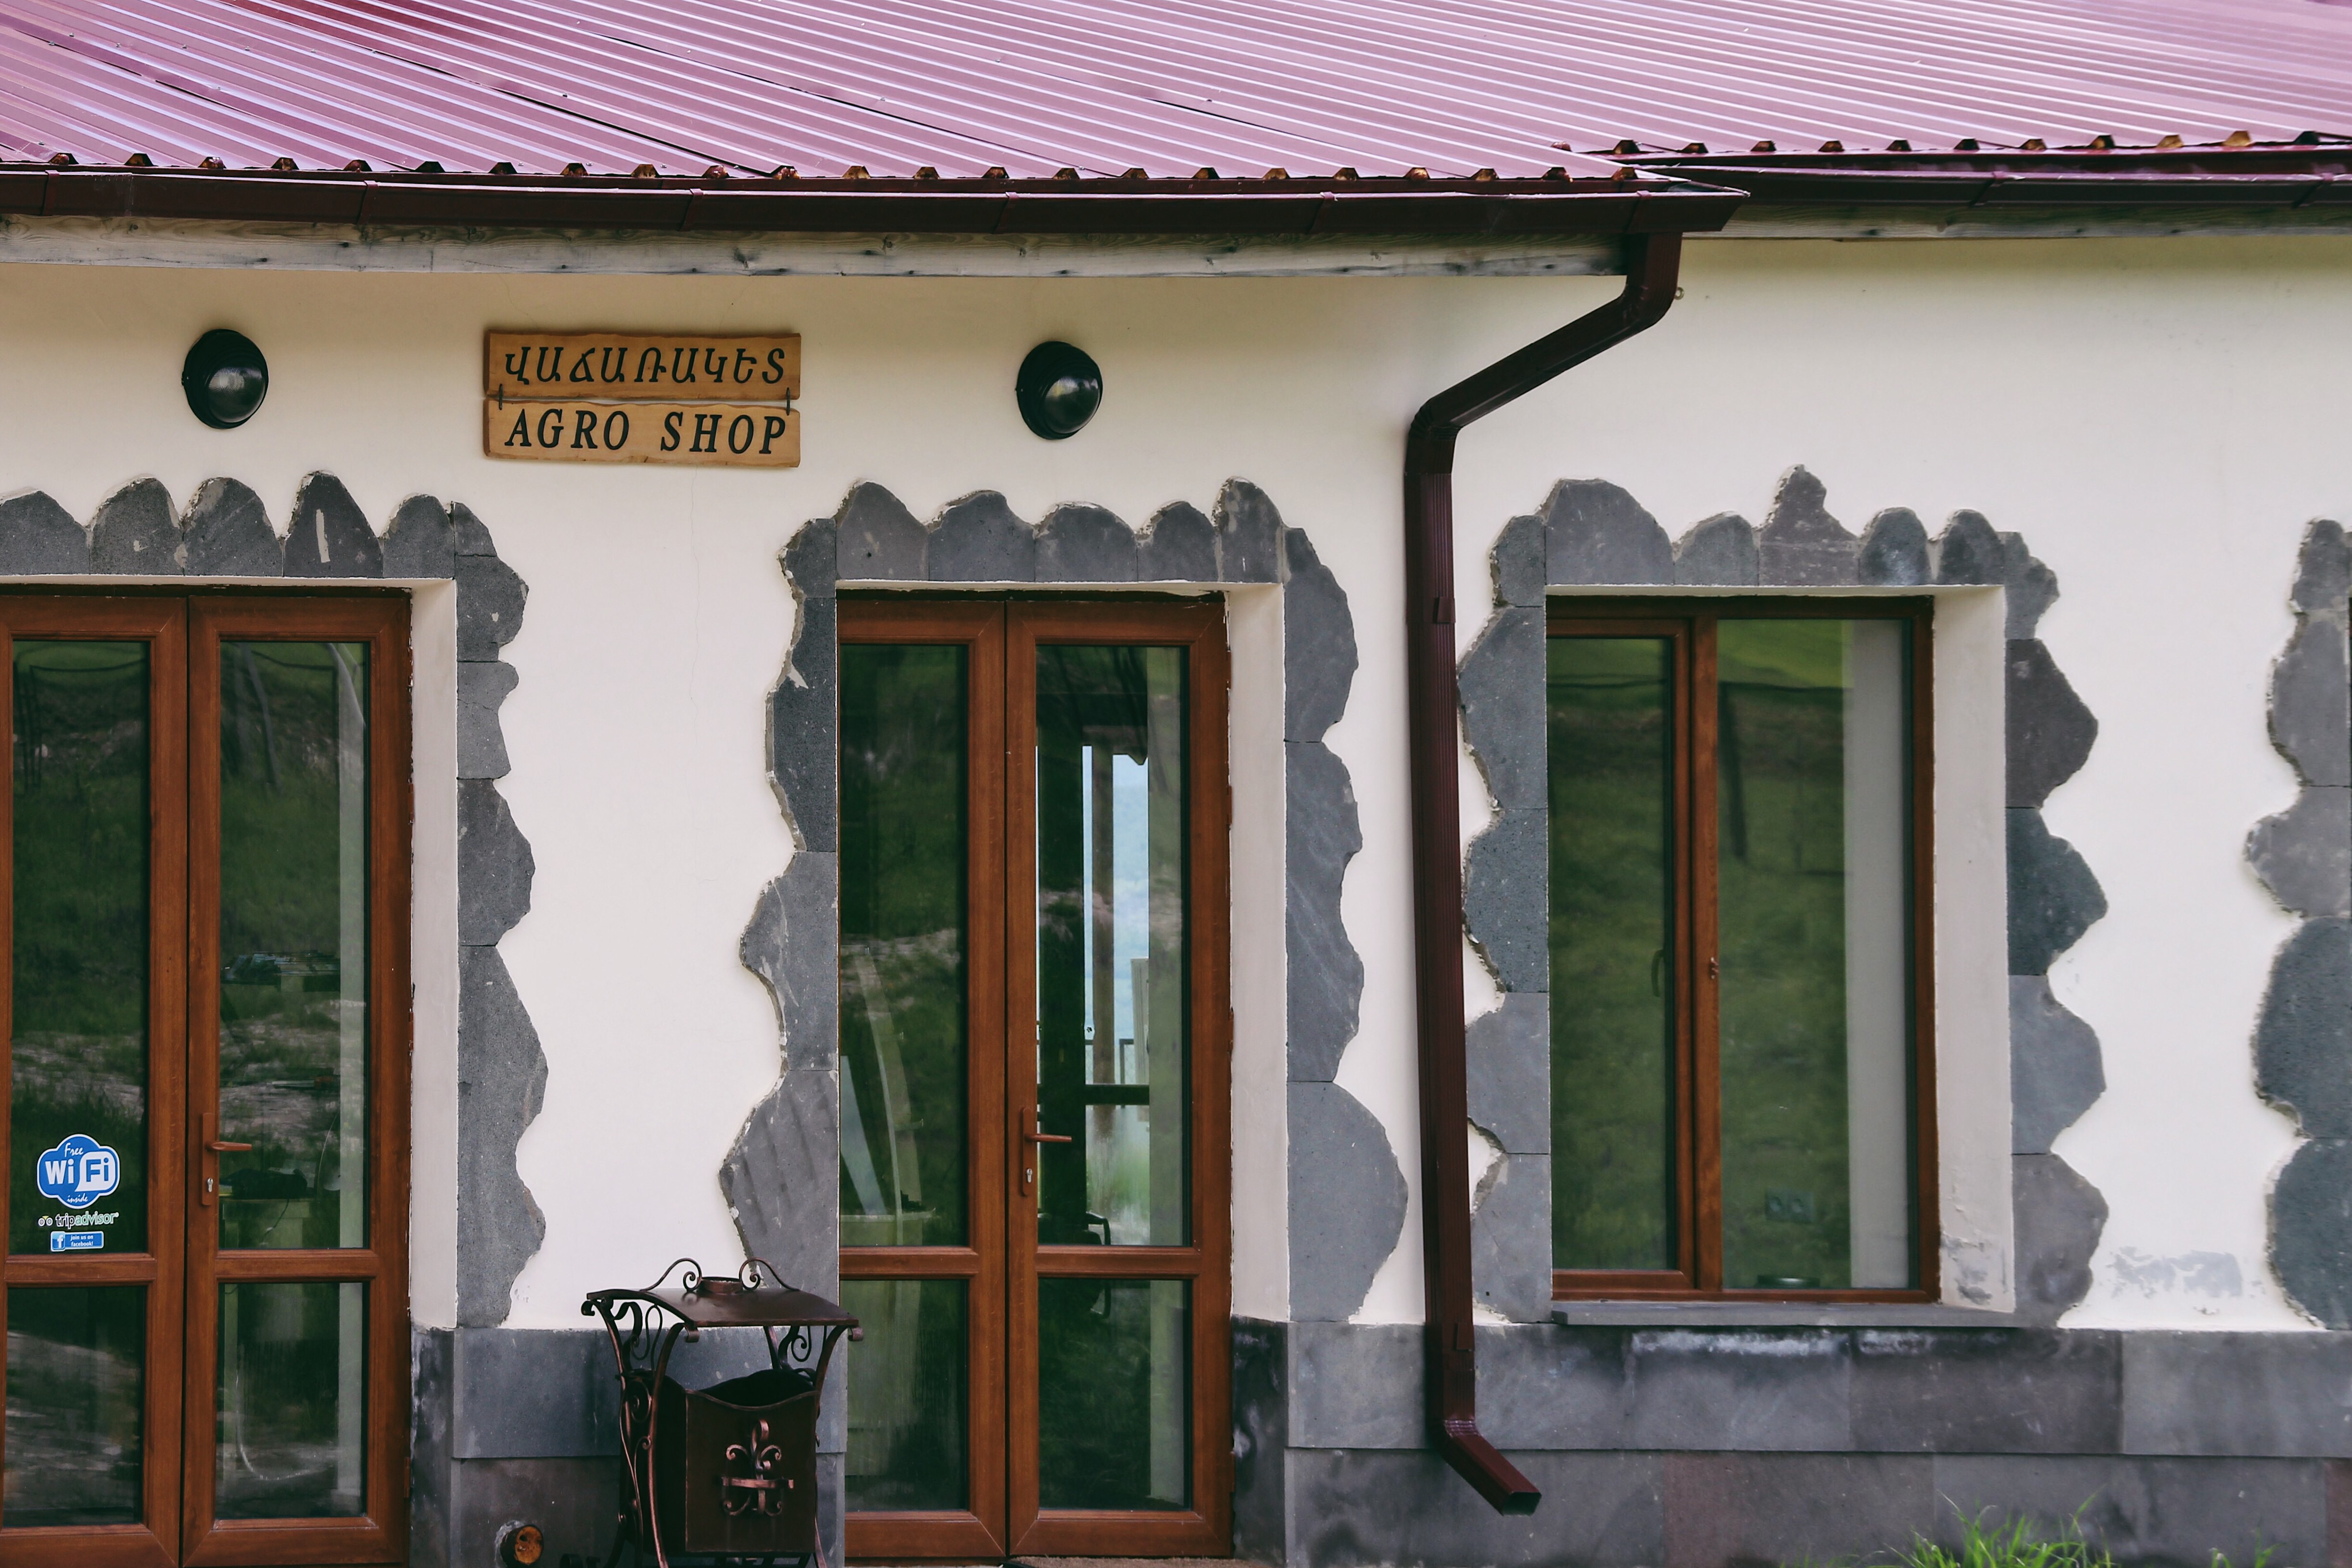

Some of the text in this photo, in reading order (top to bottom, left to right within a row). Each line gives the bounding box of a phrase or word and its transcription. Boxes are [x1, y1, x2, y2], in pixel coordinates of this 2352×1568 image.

[505, 346, 785, 385] ՎԱՃԱՌԱԿԵՏ
[504, 409, 786, 455] AGRO SHOP
[64, 1143, 84, 1157] Free
[66, 1193, 88, 1203] inside
